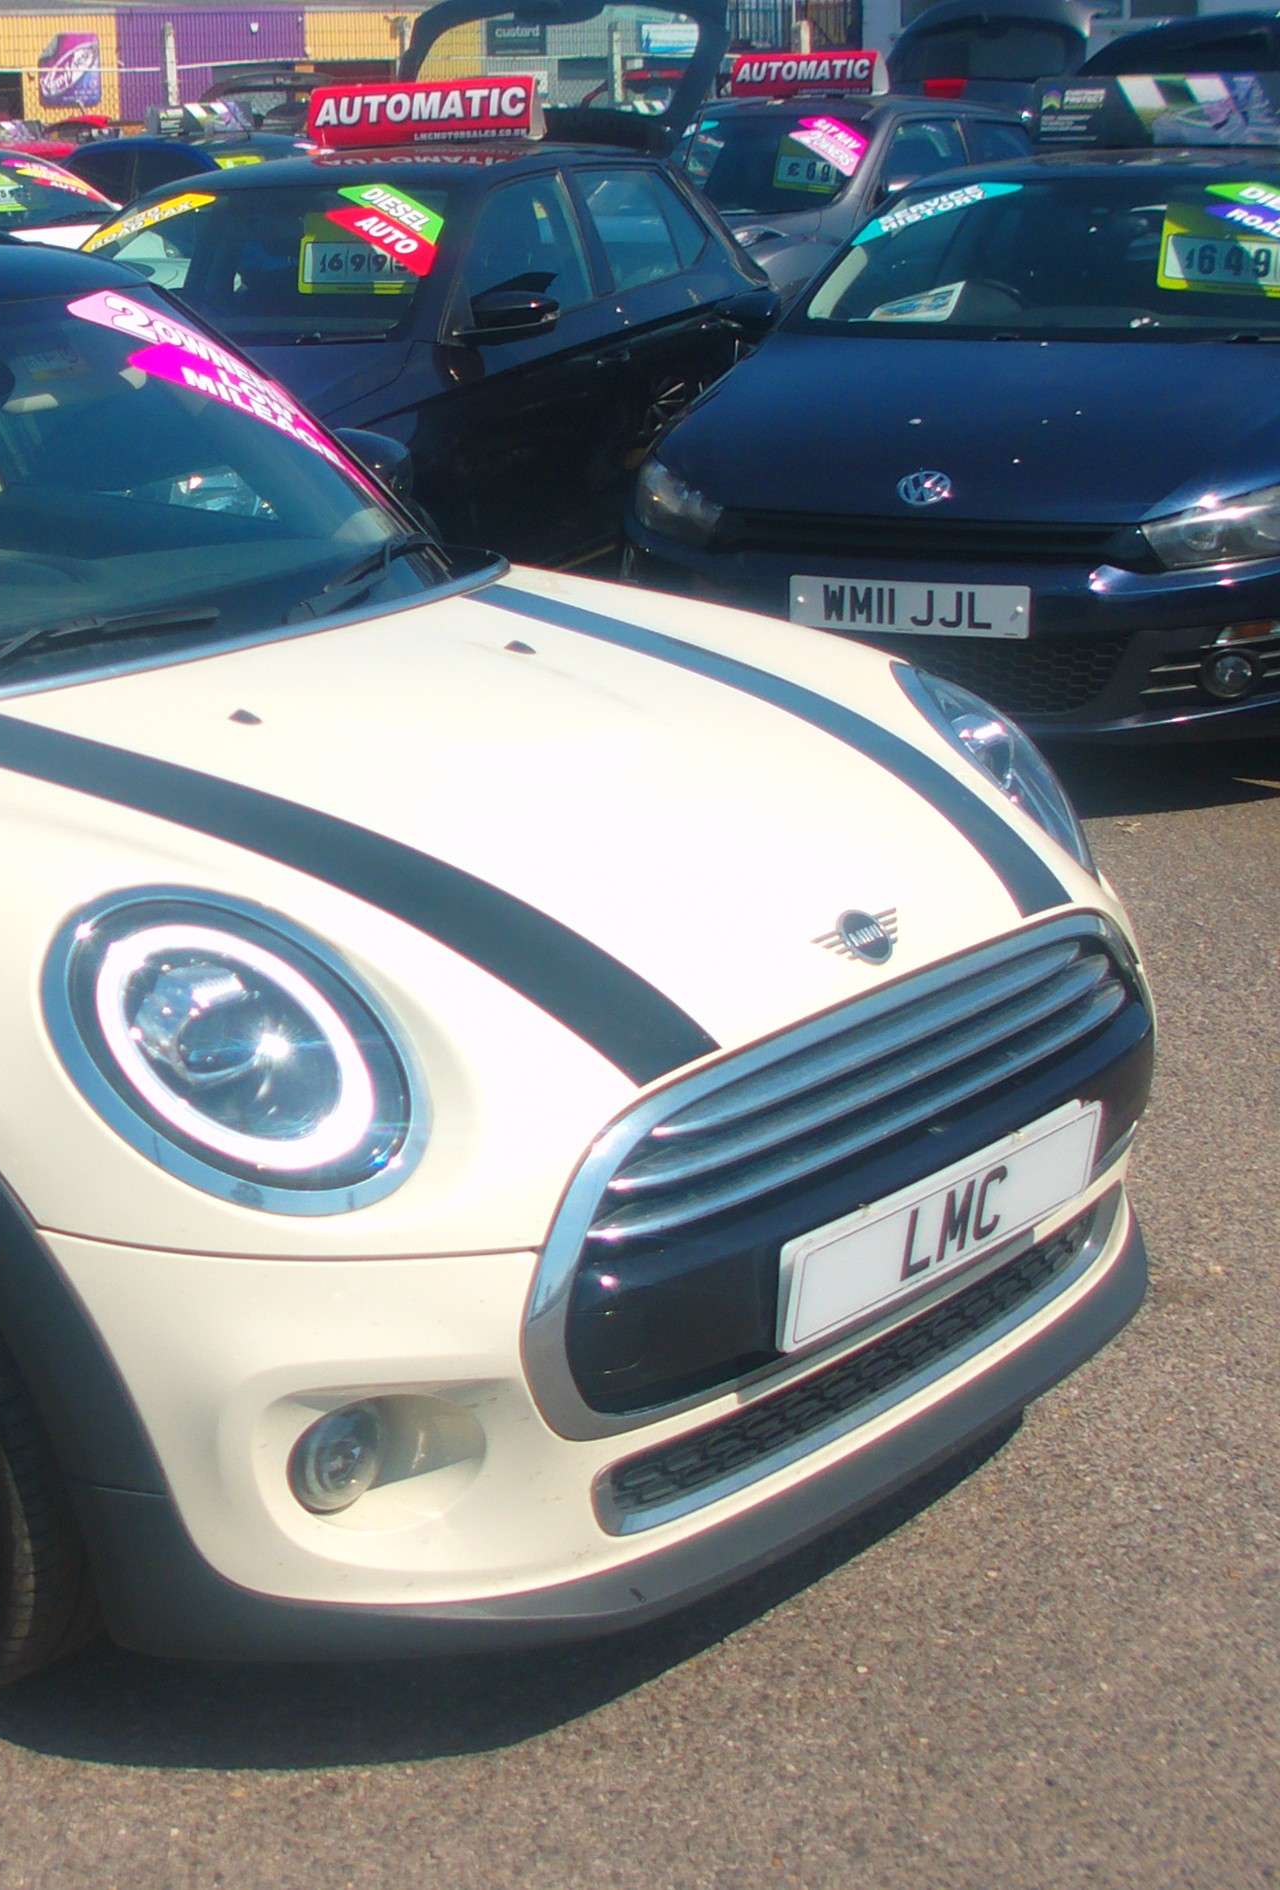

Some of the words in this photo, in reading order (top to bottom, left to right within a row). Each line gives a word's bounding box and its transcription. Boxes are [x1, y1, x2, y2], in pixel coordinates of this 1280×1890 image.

[736, 58, 870, 83] AUTOMATIC
[315, 86, 526, 127] AUTOMATIC
[360, 187, 431, 231] DIESEL
[354, 216, 419, 254] AUTO
[104, 296, 160, 343] 2
[181, 366, 346, 470] MILEAGE
[217, 366, 295, 424] LOW
[823, 583, 896, 625] WM11
[910, 589, 993, 631] JJL
[899, 1164, 1009, 1283] LMC
